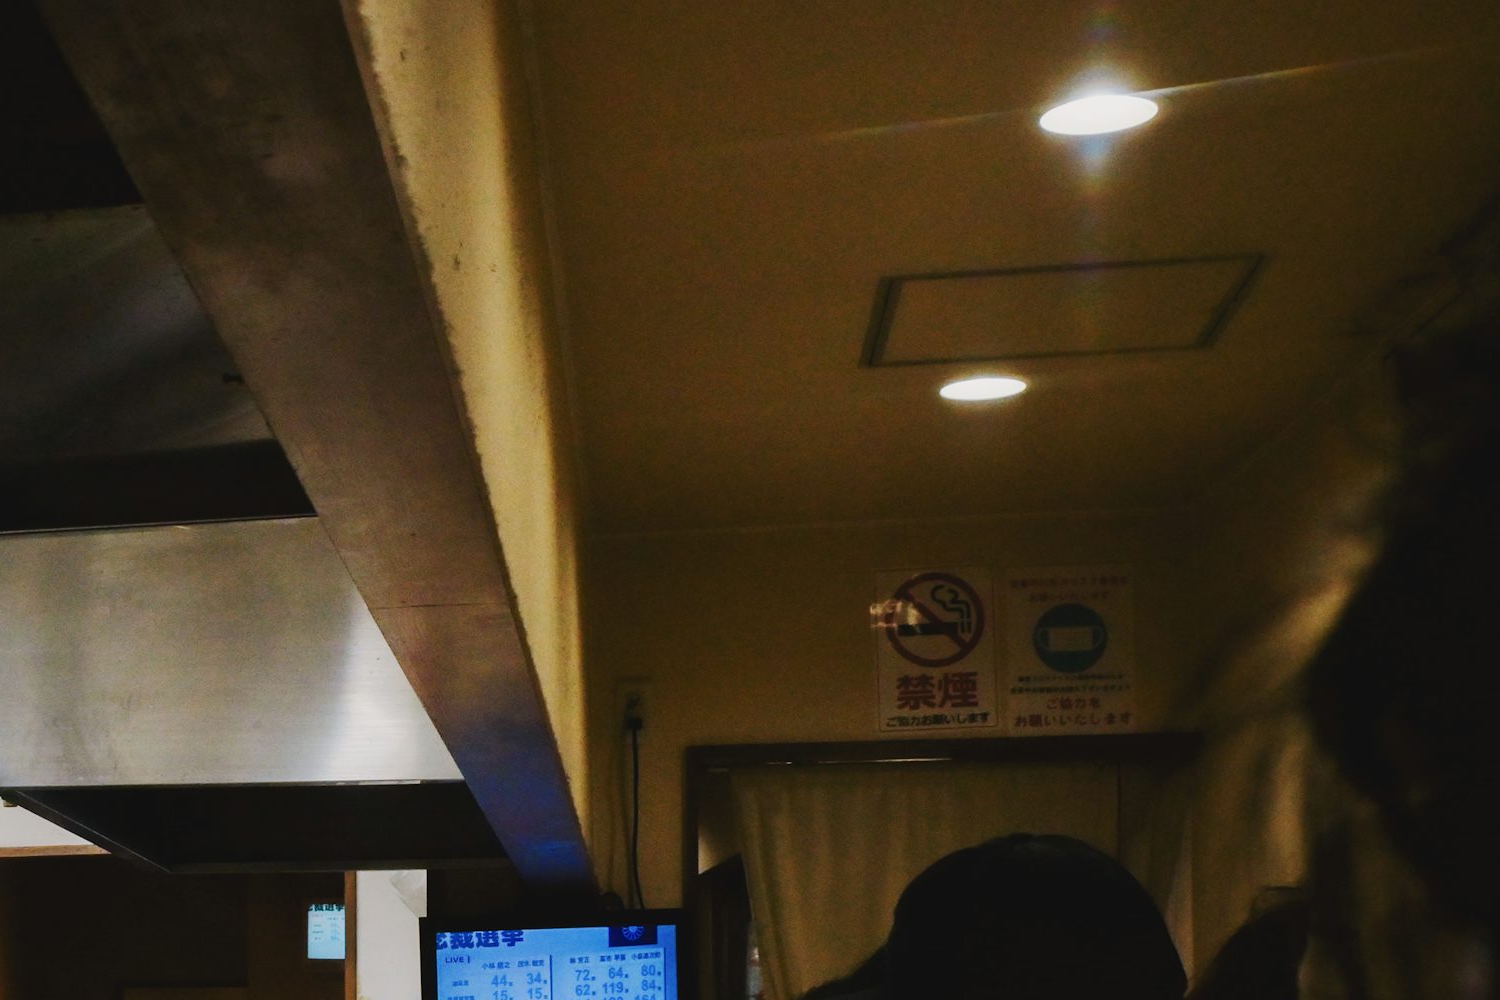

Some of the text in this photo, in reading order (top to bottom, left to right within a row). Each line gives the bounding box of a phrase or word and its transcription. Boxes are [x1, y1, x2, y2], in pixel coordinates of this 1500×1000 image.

[896, 671, 979, 710] 禁煙
[886, 711, 990, 727] ご協力お願いします
[1014, 712, 1133, 727] お願いいたします
